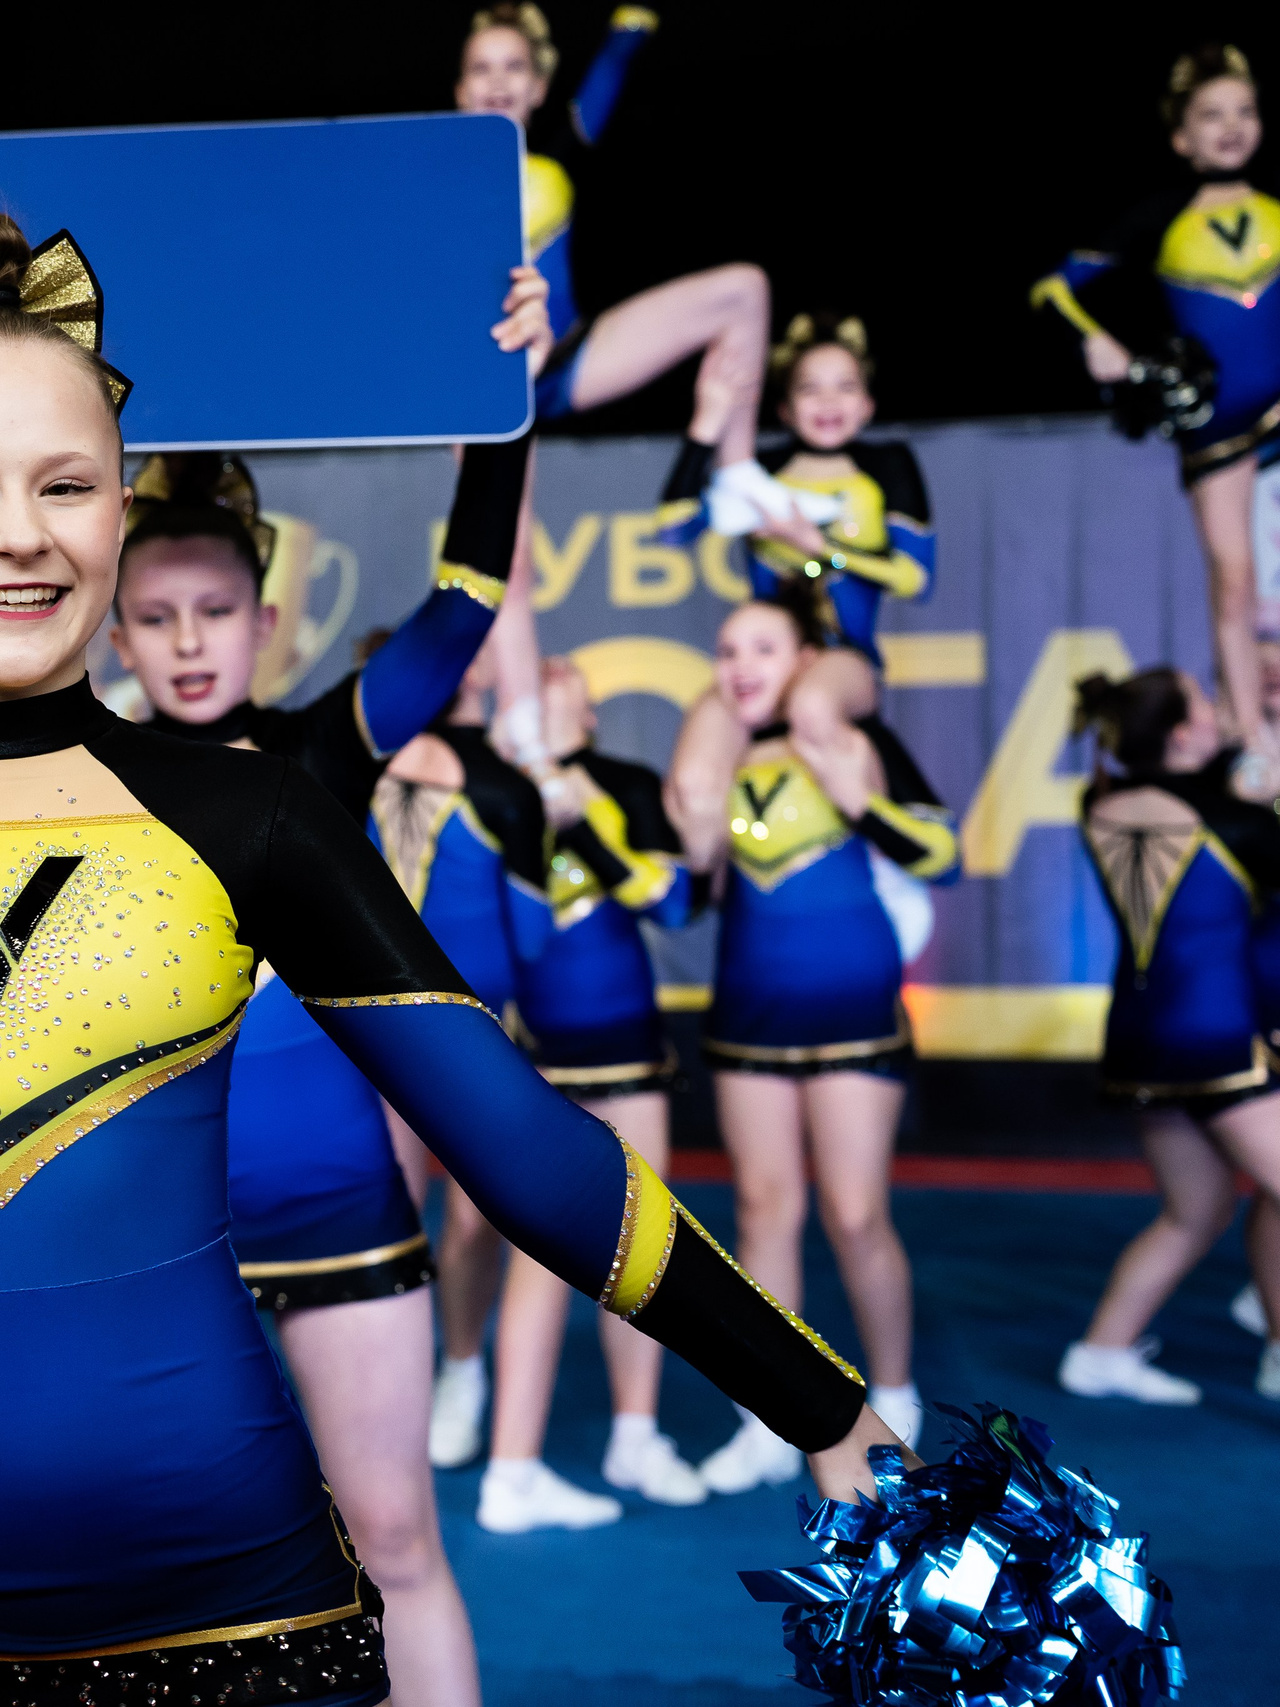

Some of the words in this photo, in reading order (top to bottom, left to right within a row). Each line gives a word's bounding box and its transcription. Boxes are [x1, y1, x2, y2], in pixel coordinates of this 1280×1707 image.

[1207, 209, 1252, 252] V
[429, 512, 753, 613] УБО
[741, 771, 788, 821] V
